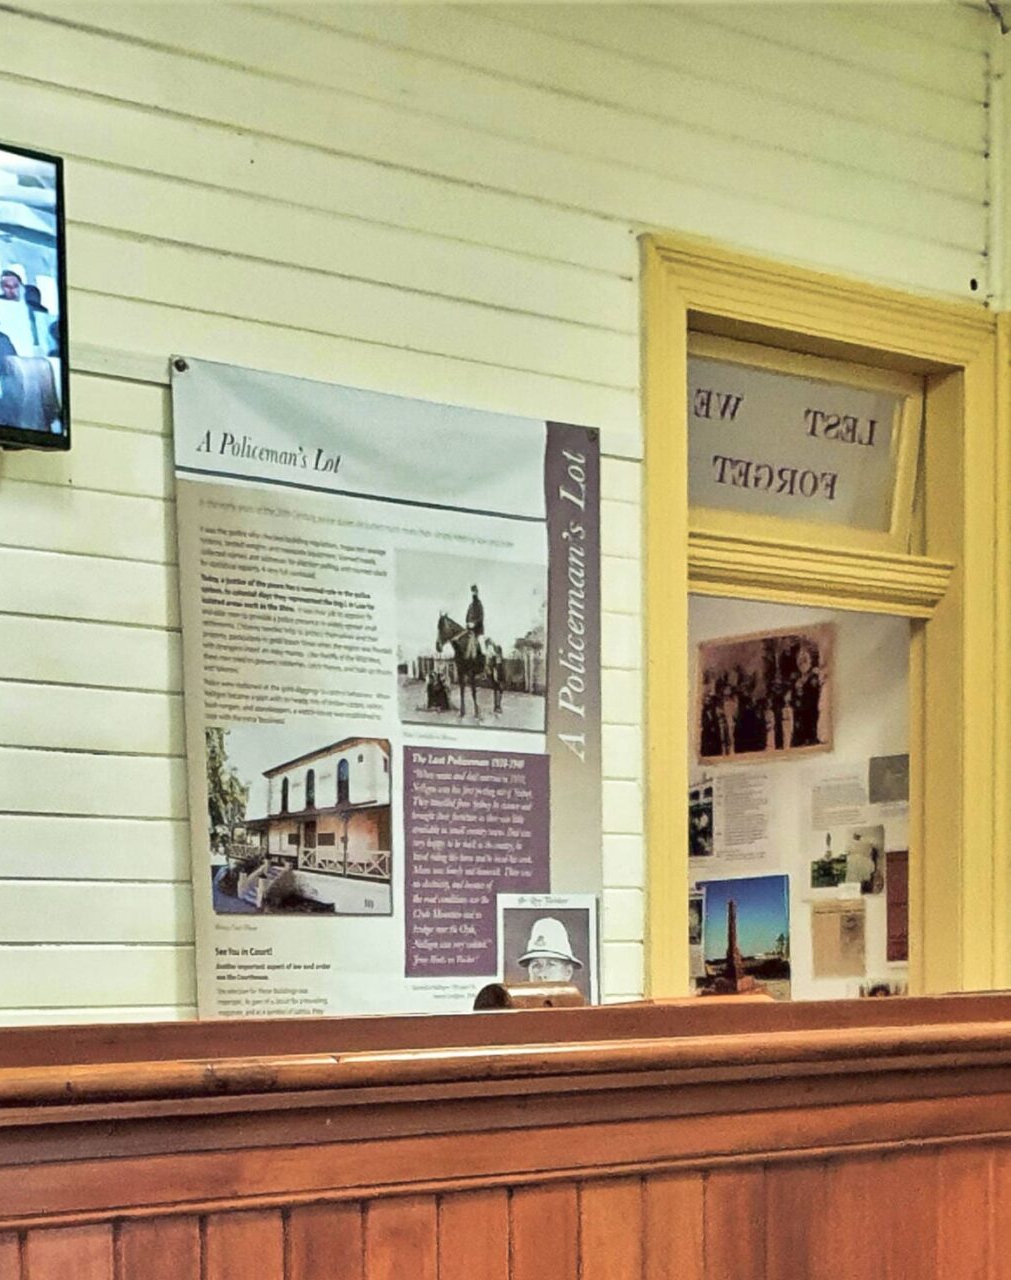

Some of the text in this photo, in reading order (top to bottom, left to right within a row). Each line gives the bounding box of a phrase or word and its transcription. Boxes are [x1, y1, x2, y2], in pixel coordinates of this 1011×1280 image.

[196, 429, 341, 474] A Policeman's Lot
[558, 449, 586, 764] A Policeman's Lot
